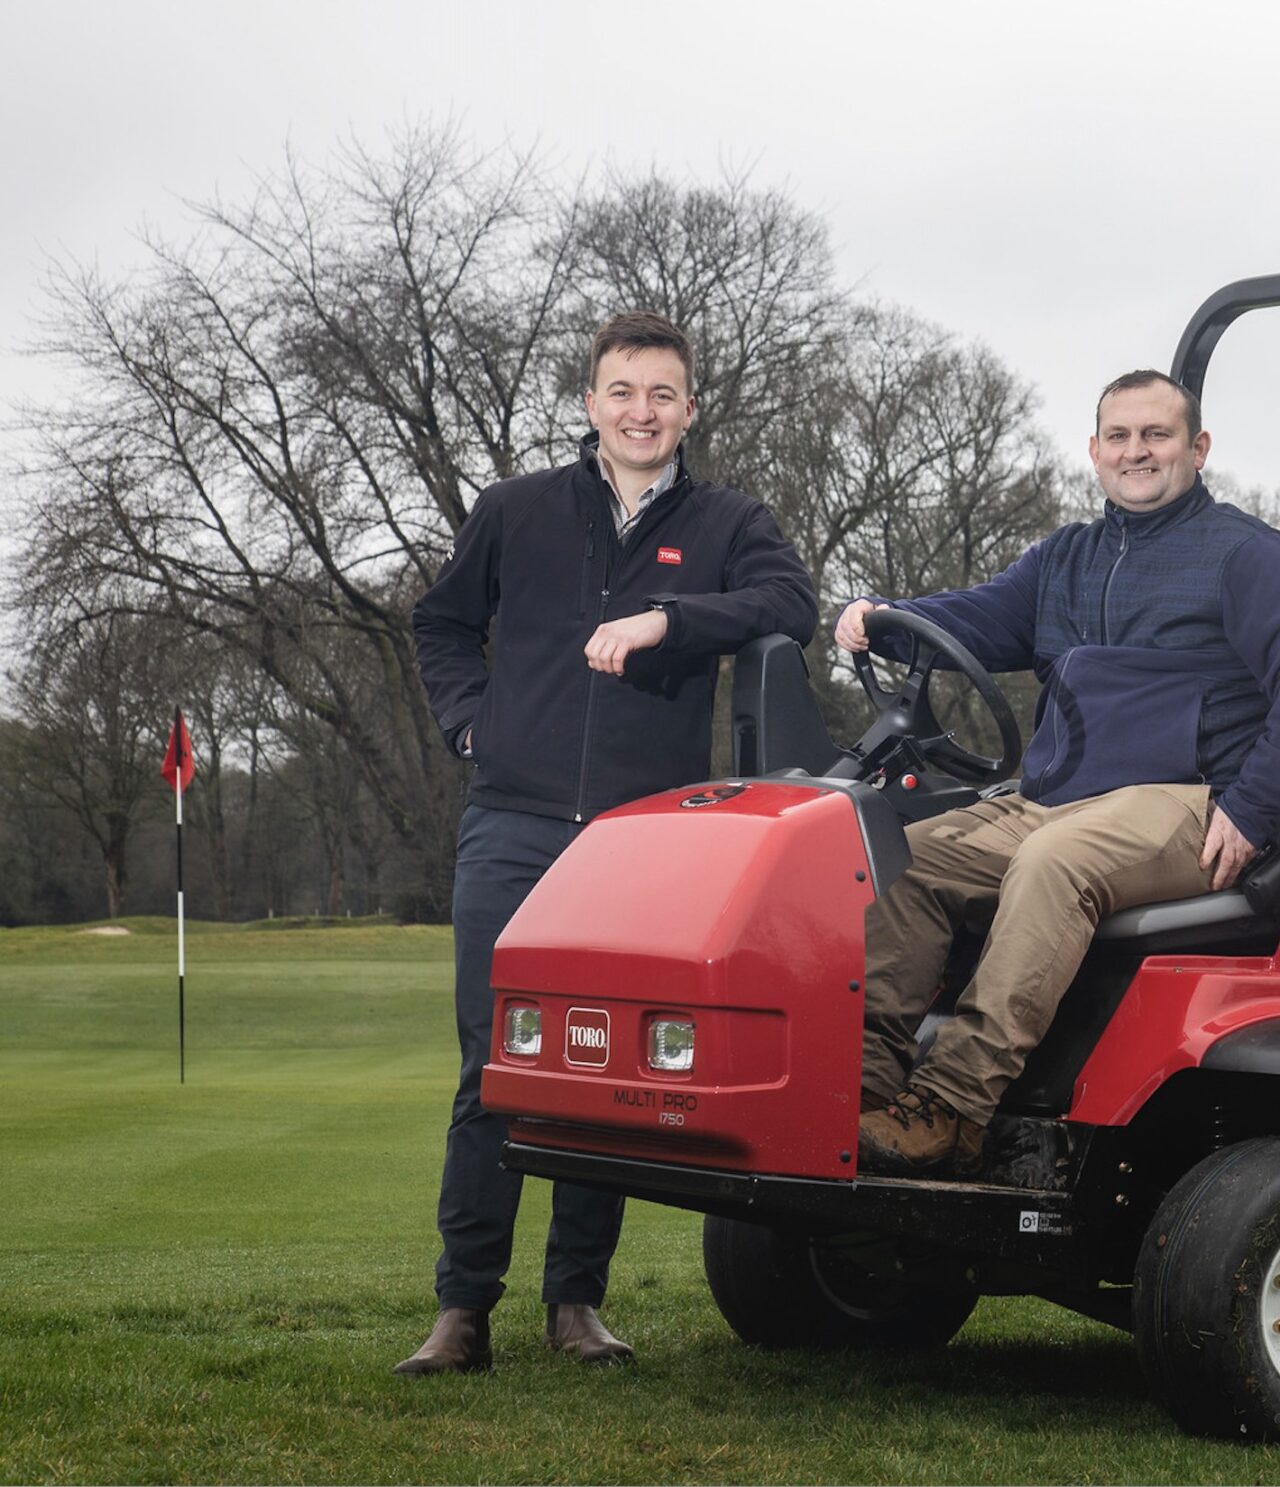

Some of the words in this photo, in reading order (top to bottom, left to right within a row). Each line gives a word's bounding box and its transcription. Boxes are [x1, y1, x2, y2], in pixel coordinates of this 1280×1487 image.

[660, 551, 681, 560] TORO
[569, 1025, 606, 1049] TORO
[613, 1090, 656, 1108] MULTI
[663, 1093, 698, 1111] PRO
[659, 1112, 685, 1126] 1750
